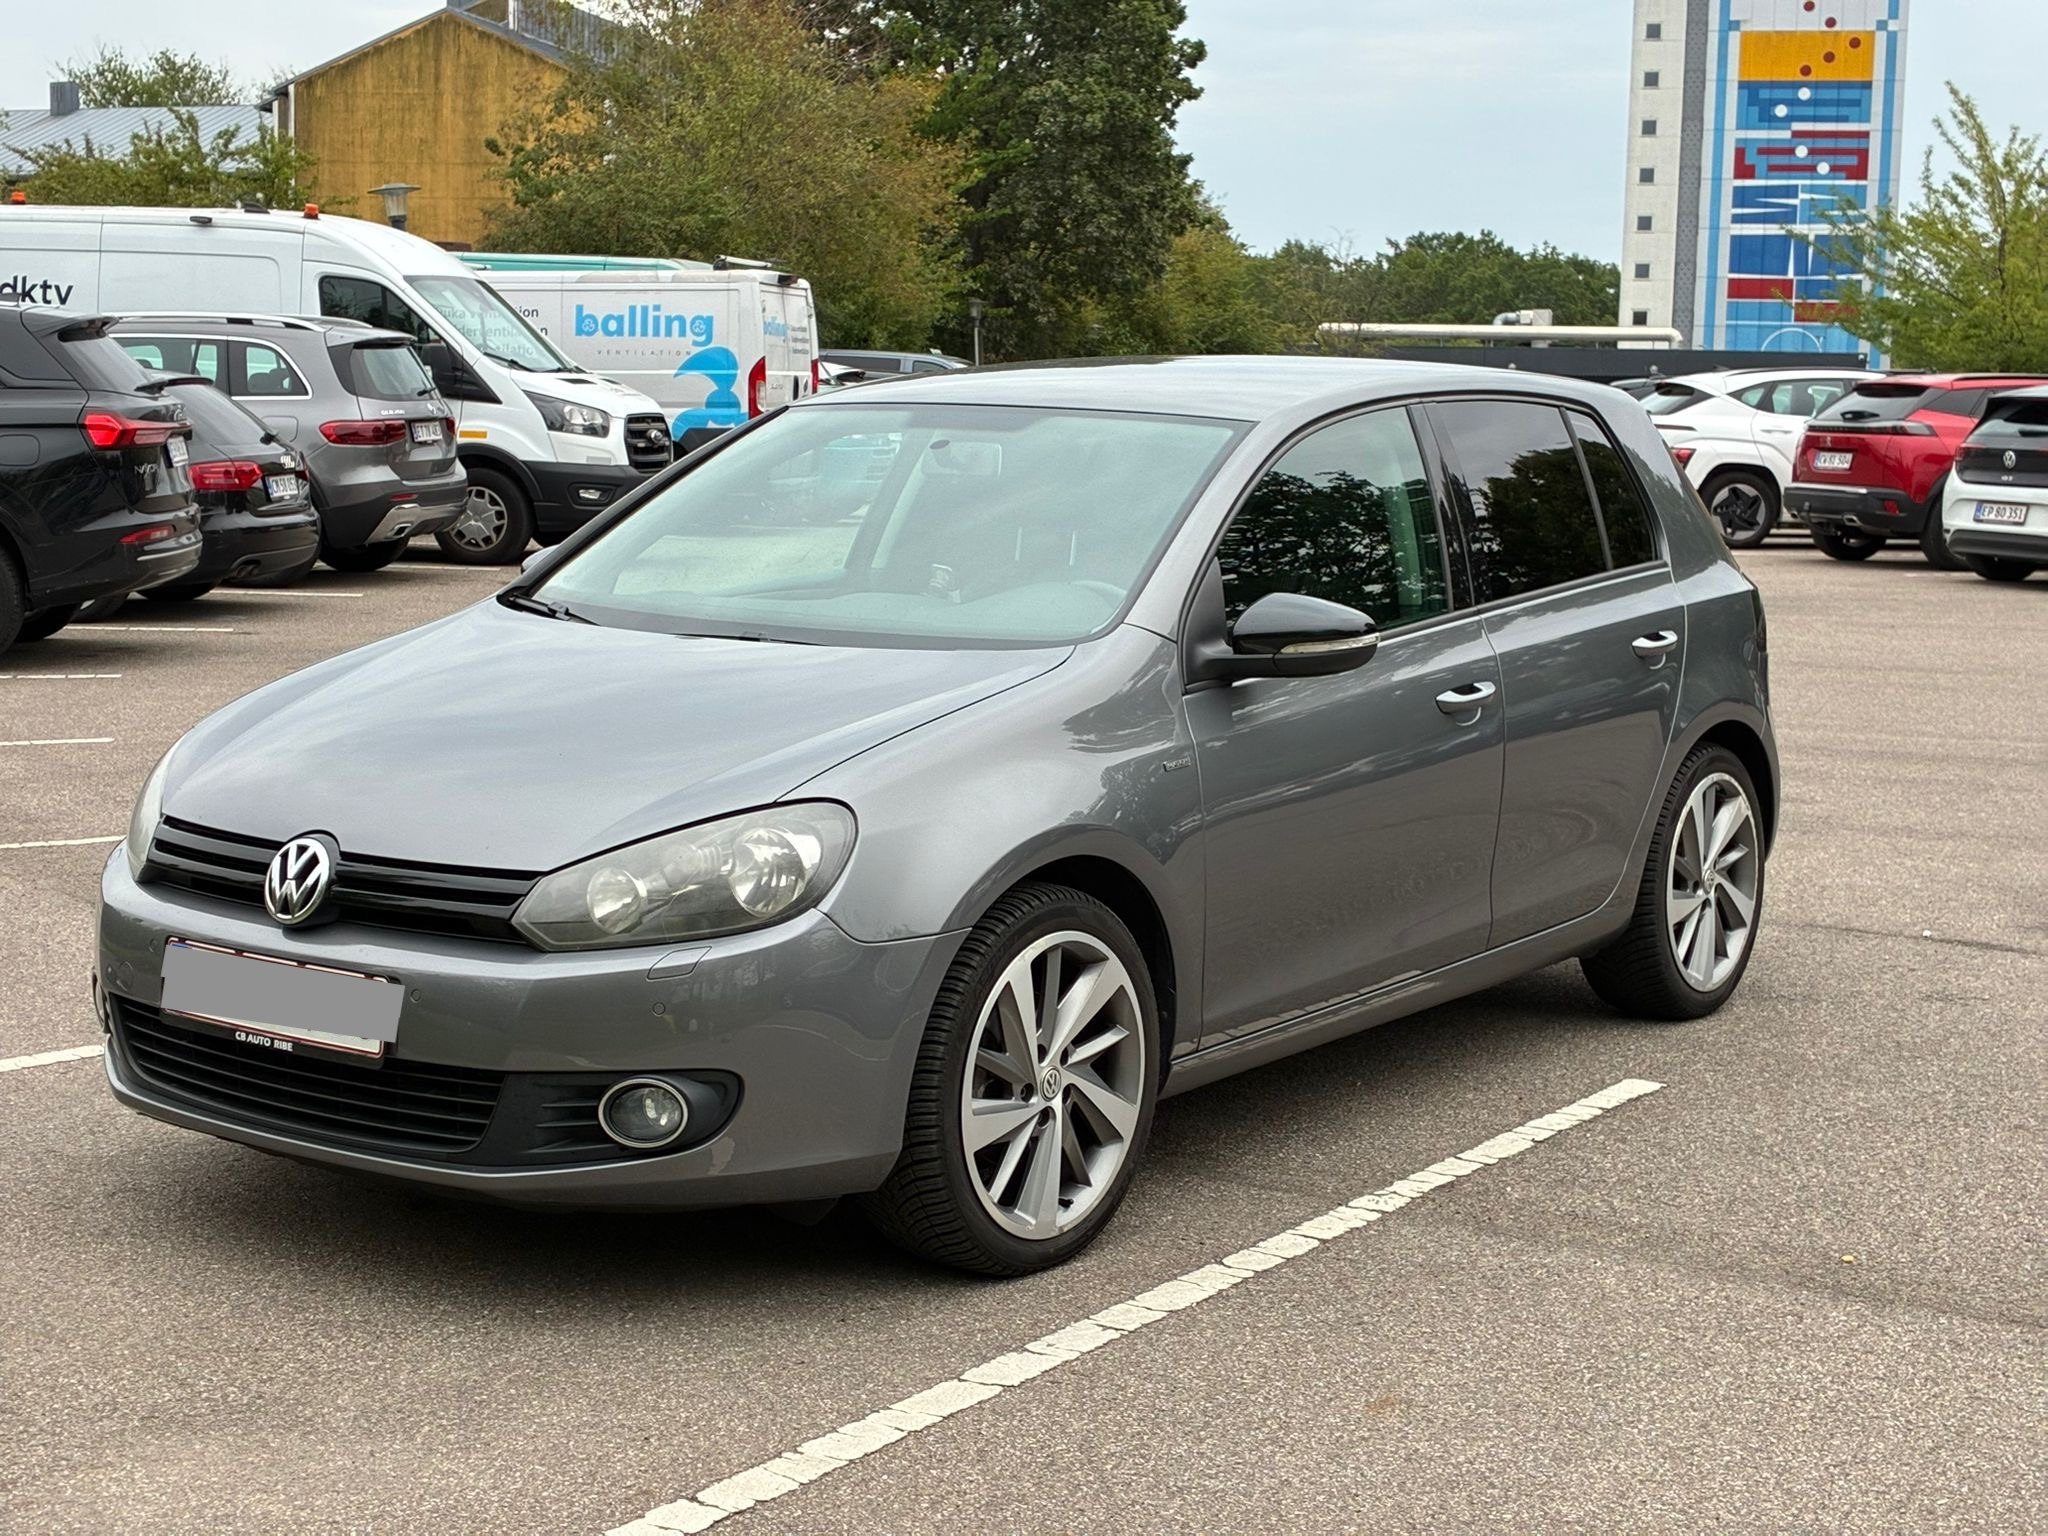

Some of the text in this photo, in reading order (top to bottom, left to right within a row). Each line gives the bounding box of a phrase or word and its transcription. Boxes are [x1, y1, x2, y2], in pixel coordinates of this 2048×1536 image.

[575, 304, 714, 347] balling
[1982, 505, 1994, 517] EP
[2008, 507, 2023, 520] 351
[235, 1031, 293, 1052] CB AUTO RIBE
